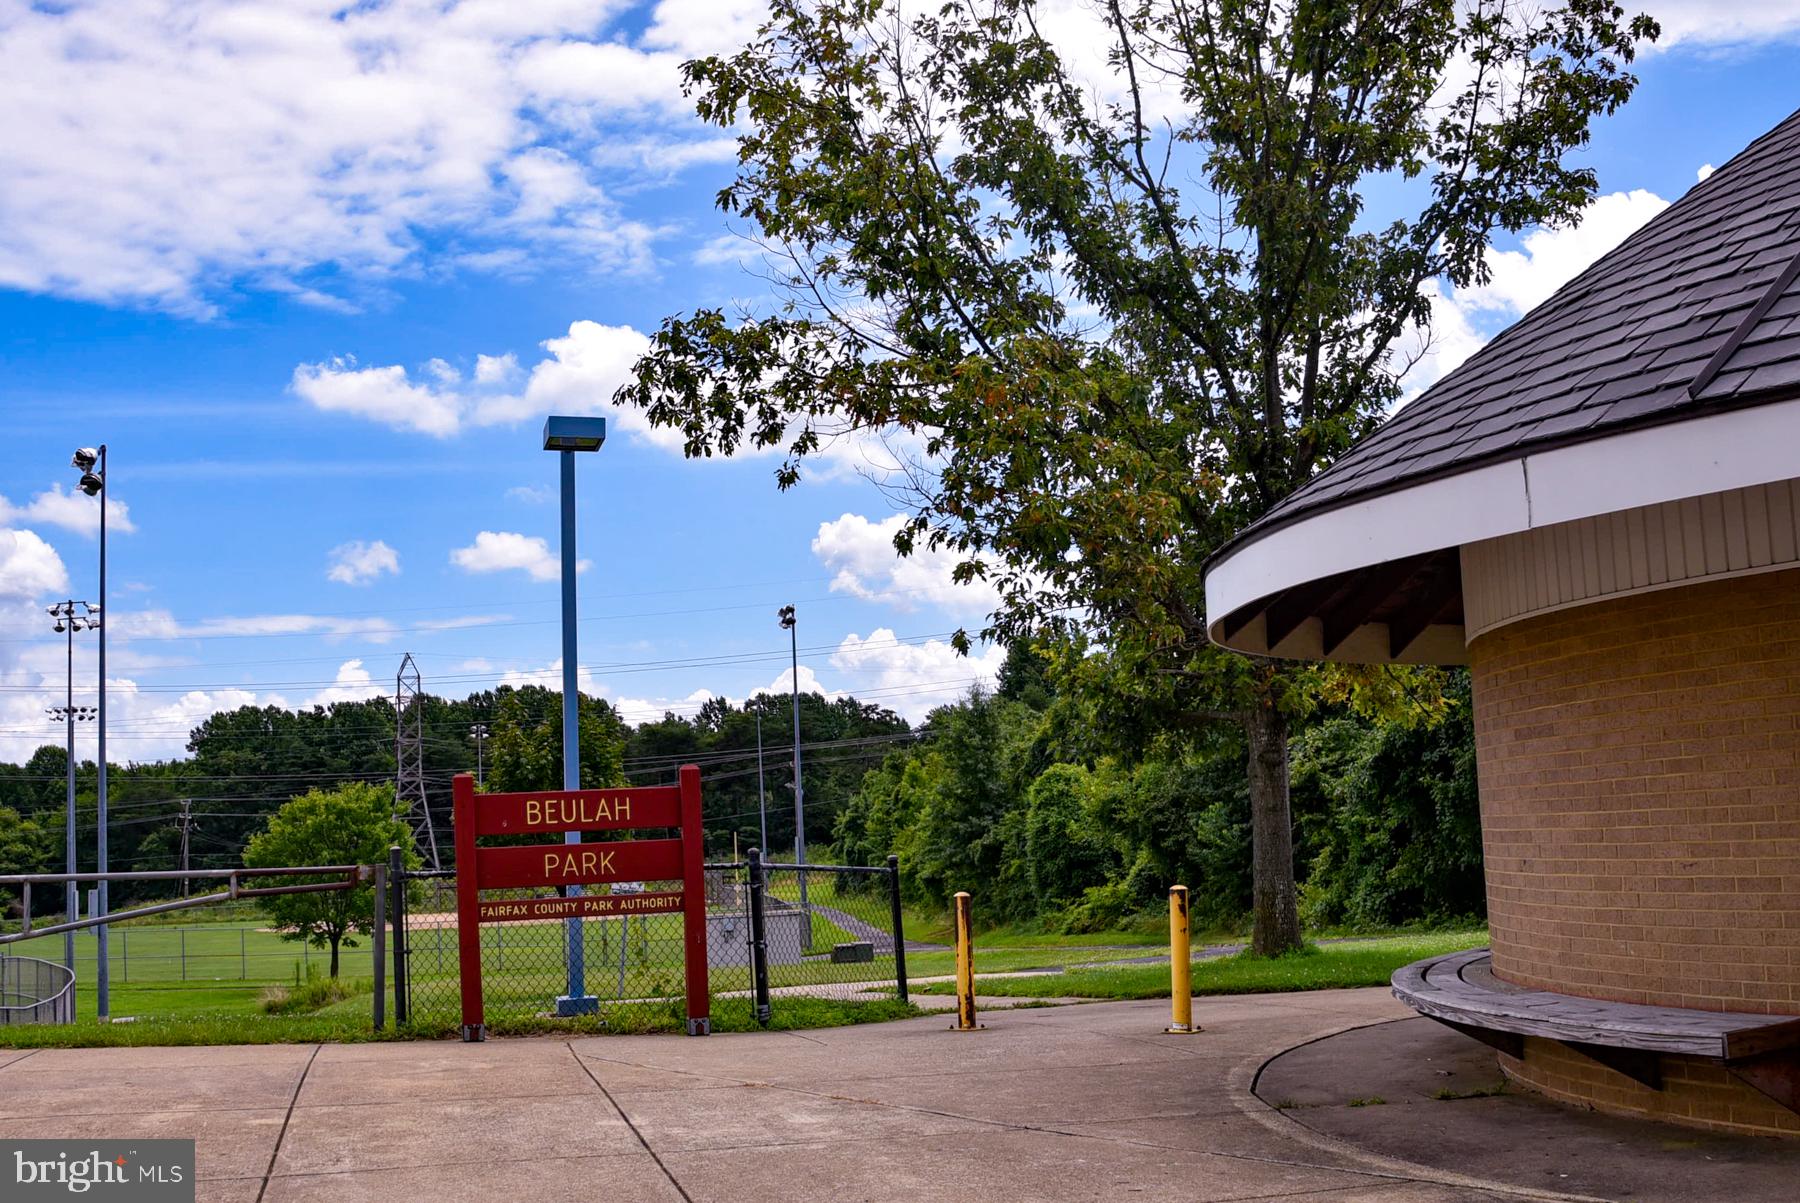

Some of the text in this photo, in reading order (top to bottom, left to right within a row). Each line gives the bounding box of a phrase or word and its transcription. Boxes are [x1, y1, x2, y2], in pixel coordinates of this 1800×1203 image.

[526, 797, 631, 825] BEULAH
[544, 851, 616, 878] PARK
[481, 896, 682, 917] FAIRFAX COUNTY PARK AUTHORITY
